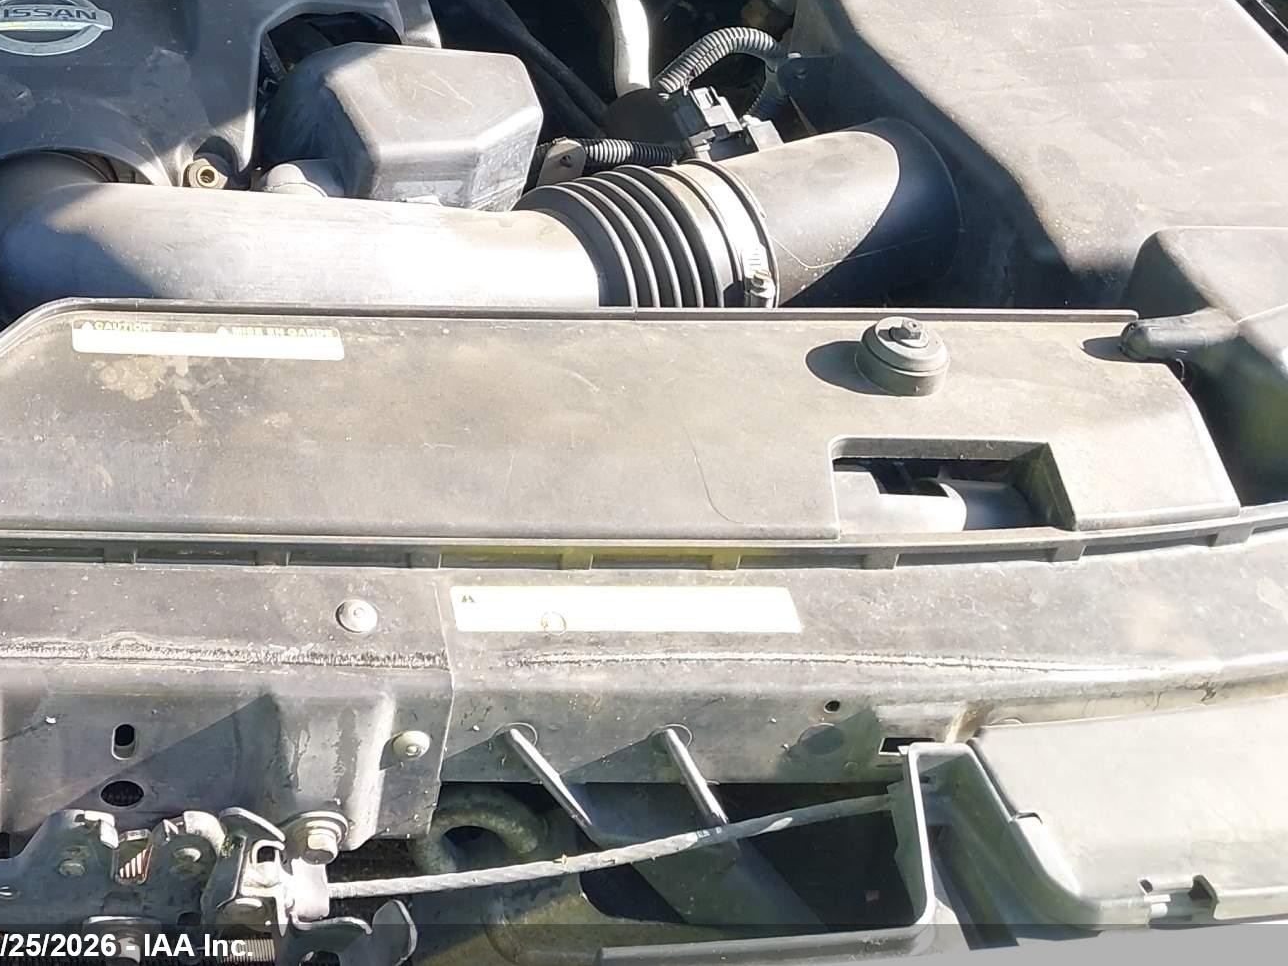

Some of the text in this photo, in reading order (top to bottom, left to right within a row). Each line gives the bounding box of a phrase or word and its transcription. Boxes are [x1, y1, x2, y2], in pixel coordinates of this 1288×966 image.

[93, 321, 152, 332] CAUTION
[231, 326, 264, 337] MISE
[287, 328, 334, 338] GARDE
